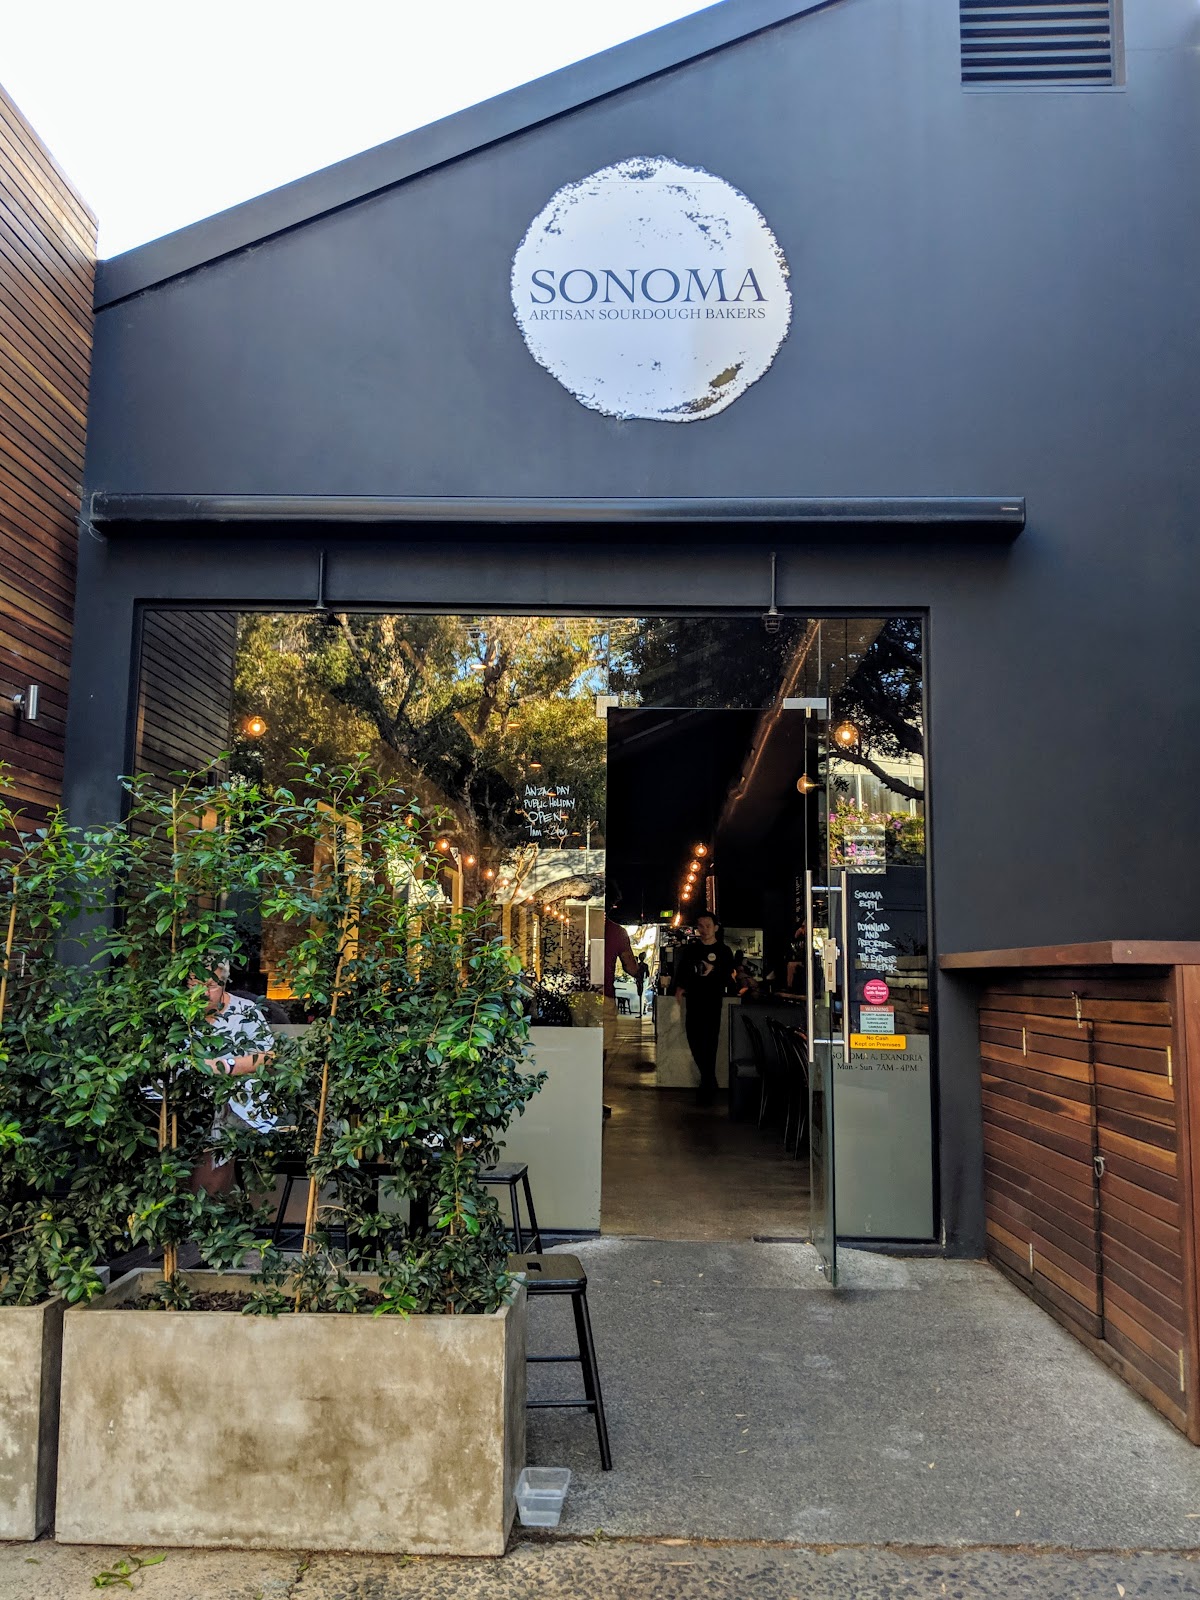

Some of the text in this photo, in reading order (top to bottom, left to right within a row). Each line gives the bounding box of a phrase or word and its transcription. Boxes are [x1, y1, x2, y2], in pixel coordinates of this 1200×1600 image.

[530, 268, 769, 304] SONOMA
[529, 307, 766, 320] ARTISAN SOURDOUGH BAKERS
[525, 784, 570, 796] ANZAC DAY
[524, 796, 576, 809] PUBLIC HOLIDAY
[528, 810, 562, 824] OPEN
[854, 890, 883, 900] SONOMA
[865, 931, 880, 940] AND
[865, 946, 884, 955] FOR
[857, 952, 898, 964] THE EXPRESS
[837, 1063, 853, 1071] Mon
[859, 1063, 873, 1071] Sun
